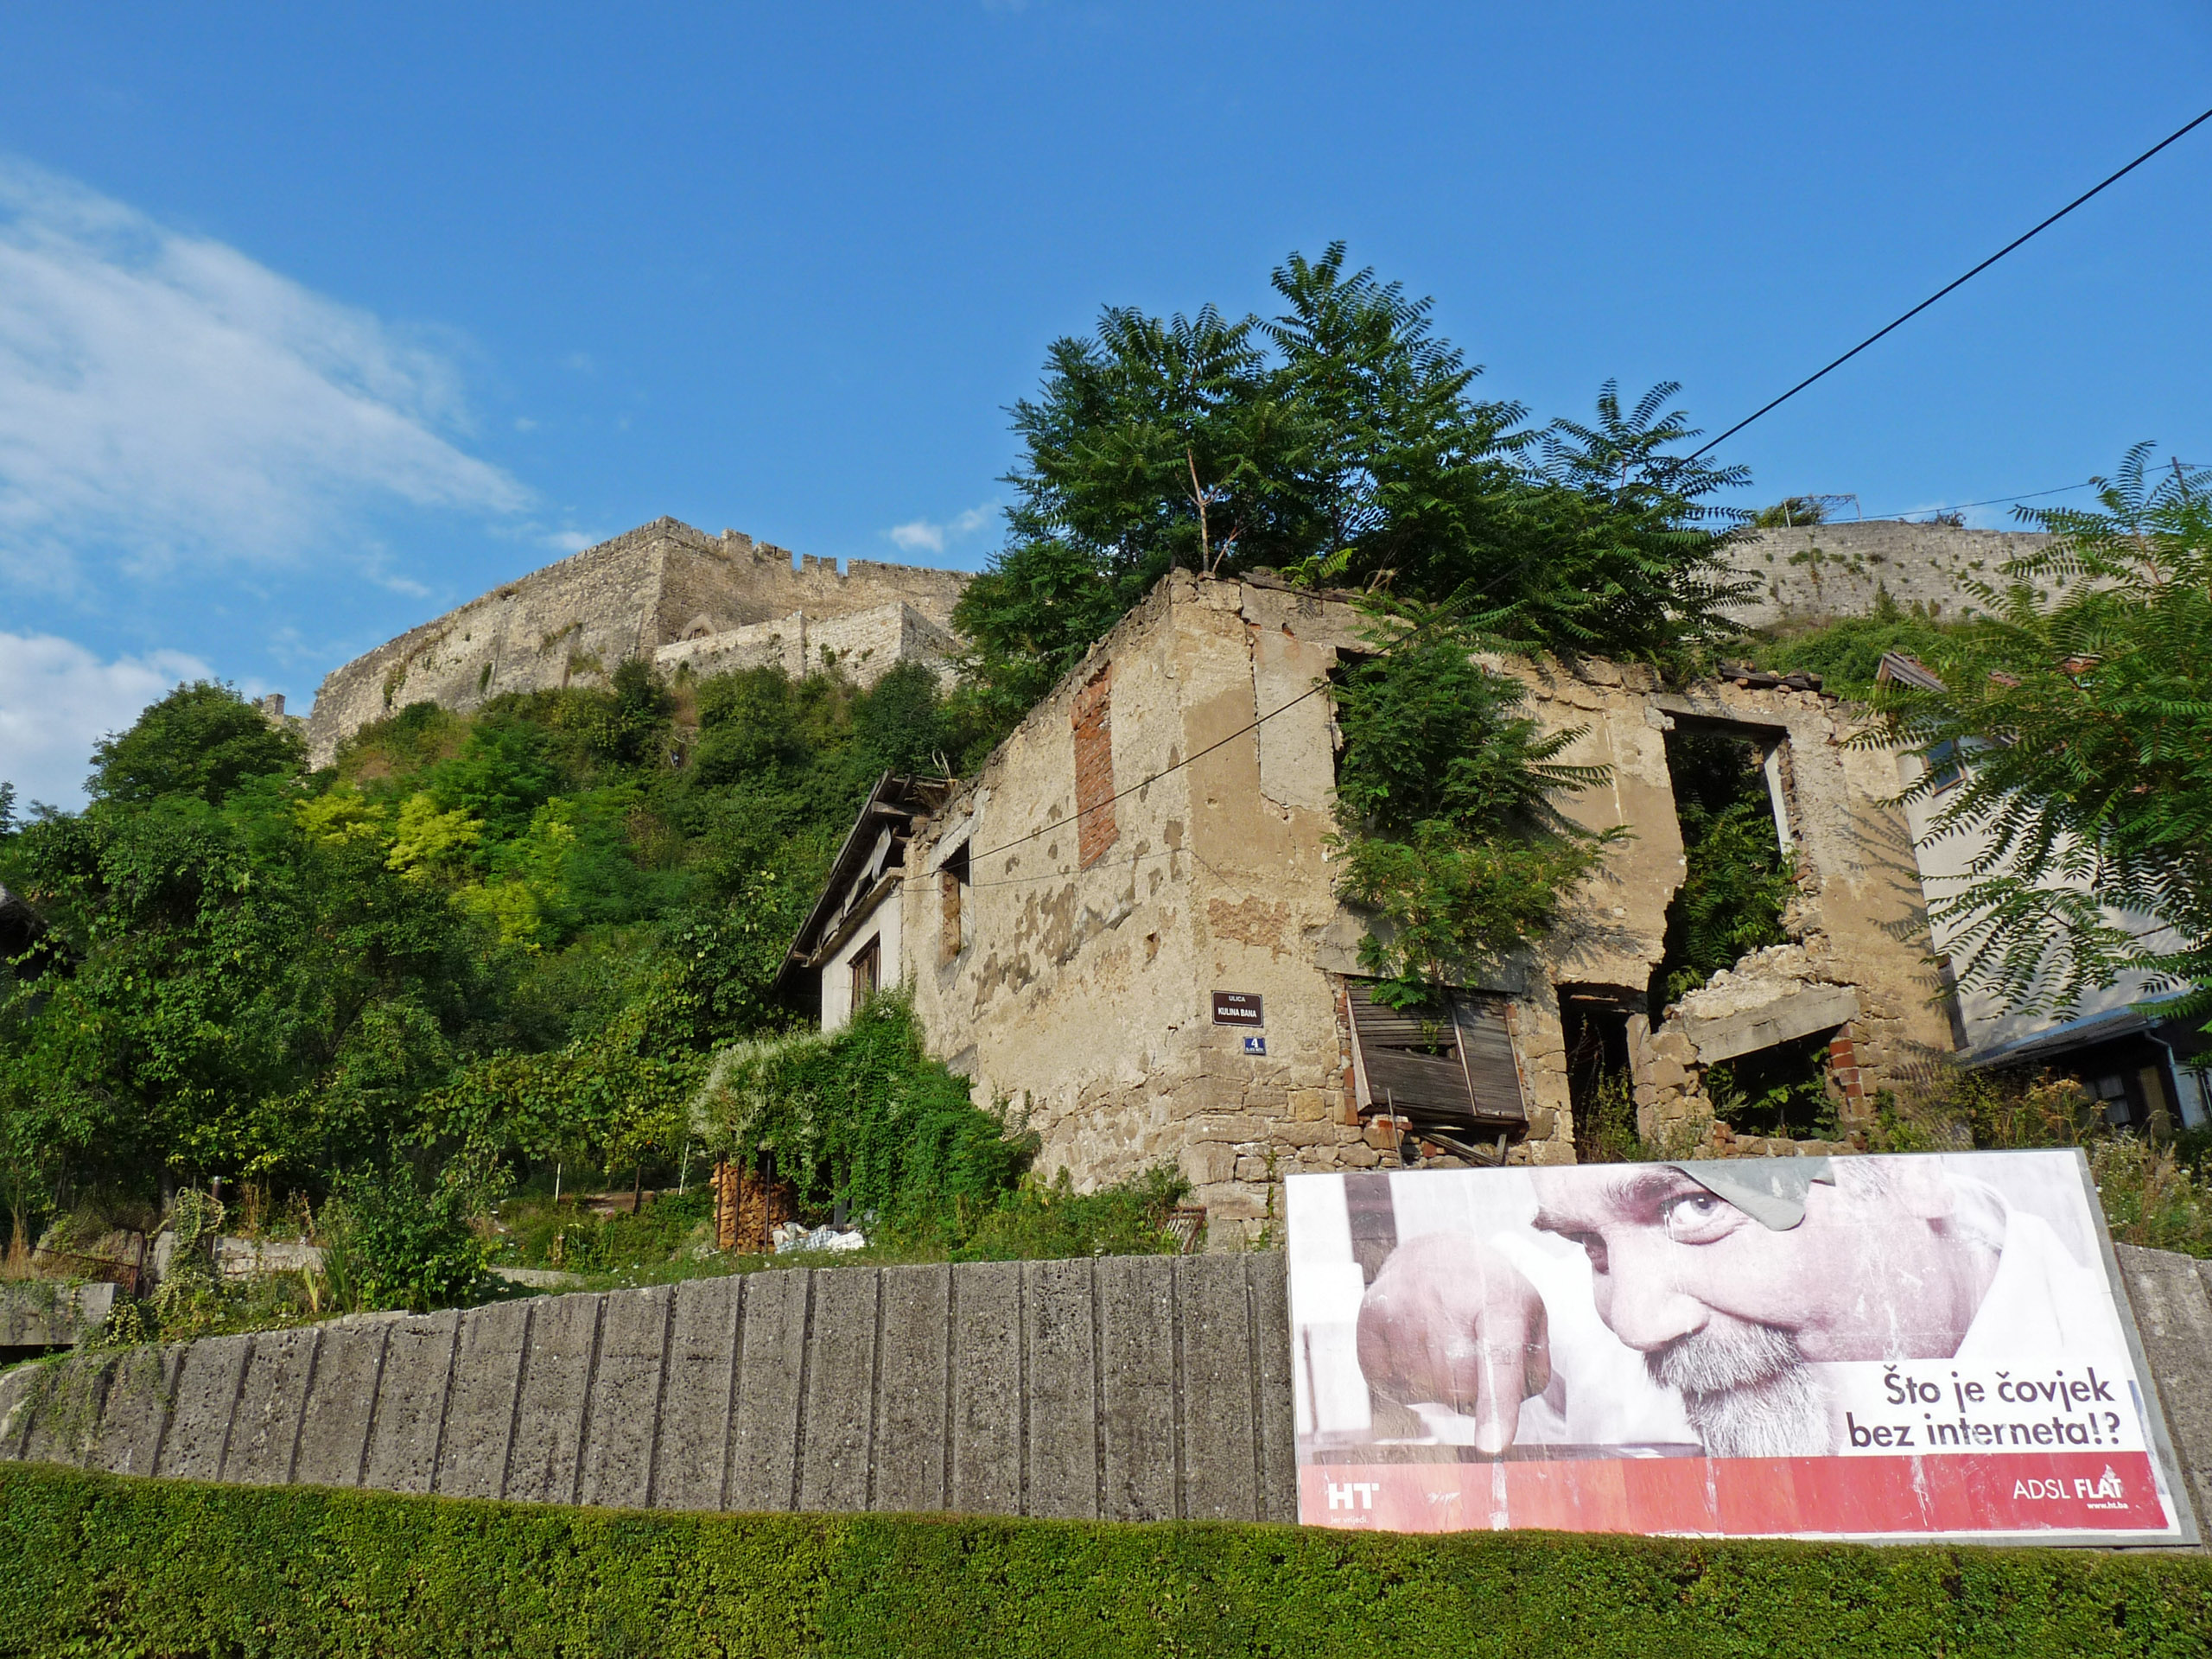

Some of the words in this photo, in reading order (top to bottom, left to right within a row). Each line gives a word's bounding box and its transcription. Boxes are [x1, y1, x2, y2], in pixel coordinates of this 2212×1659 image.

[1217, 1007, 1239, 1016] KULINA
[1240, 1008, 1257, 1017] BANA
[1250, 1038, 1259, 1048] 4
[1883, 1363, 1941, 1406] Što
[1951, 1370, 1985, 1414] je
[1996, 1367, 2116, 1412] čovjek
[1846, 1411, 1916, 1447] bez
[1923, 1411, 2121, 1446] interneta!?
[2012, 1478, 2071, 1500] ADSL
[2074, 1478, 2122, 1499] FLAT
[2087, 1501, 2129, 1510] www.ht.ba
[1331, 1515, 1341, 1524] Jer
